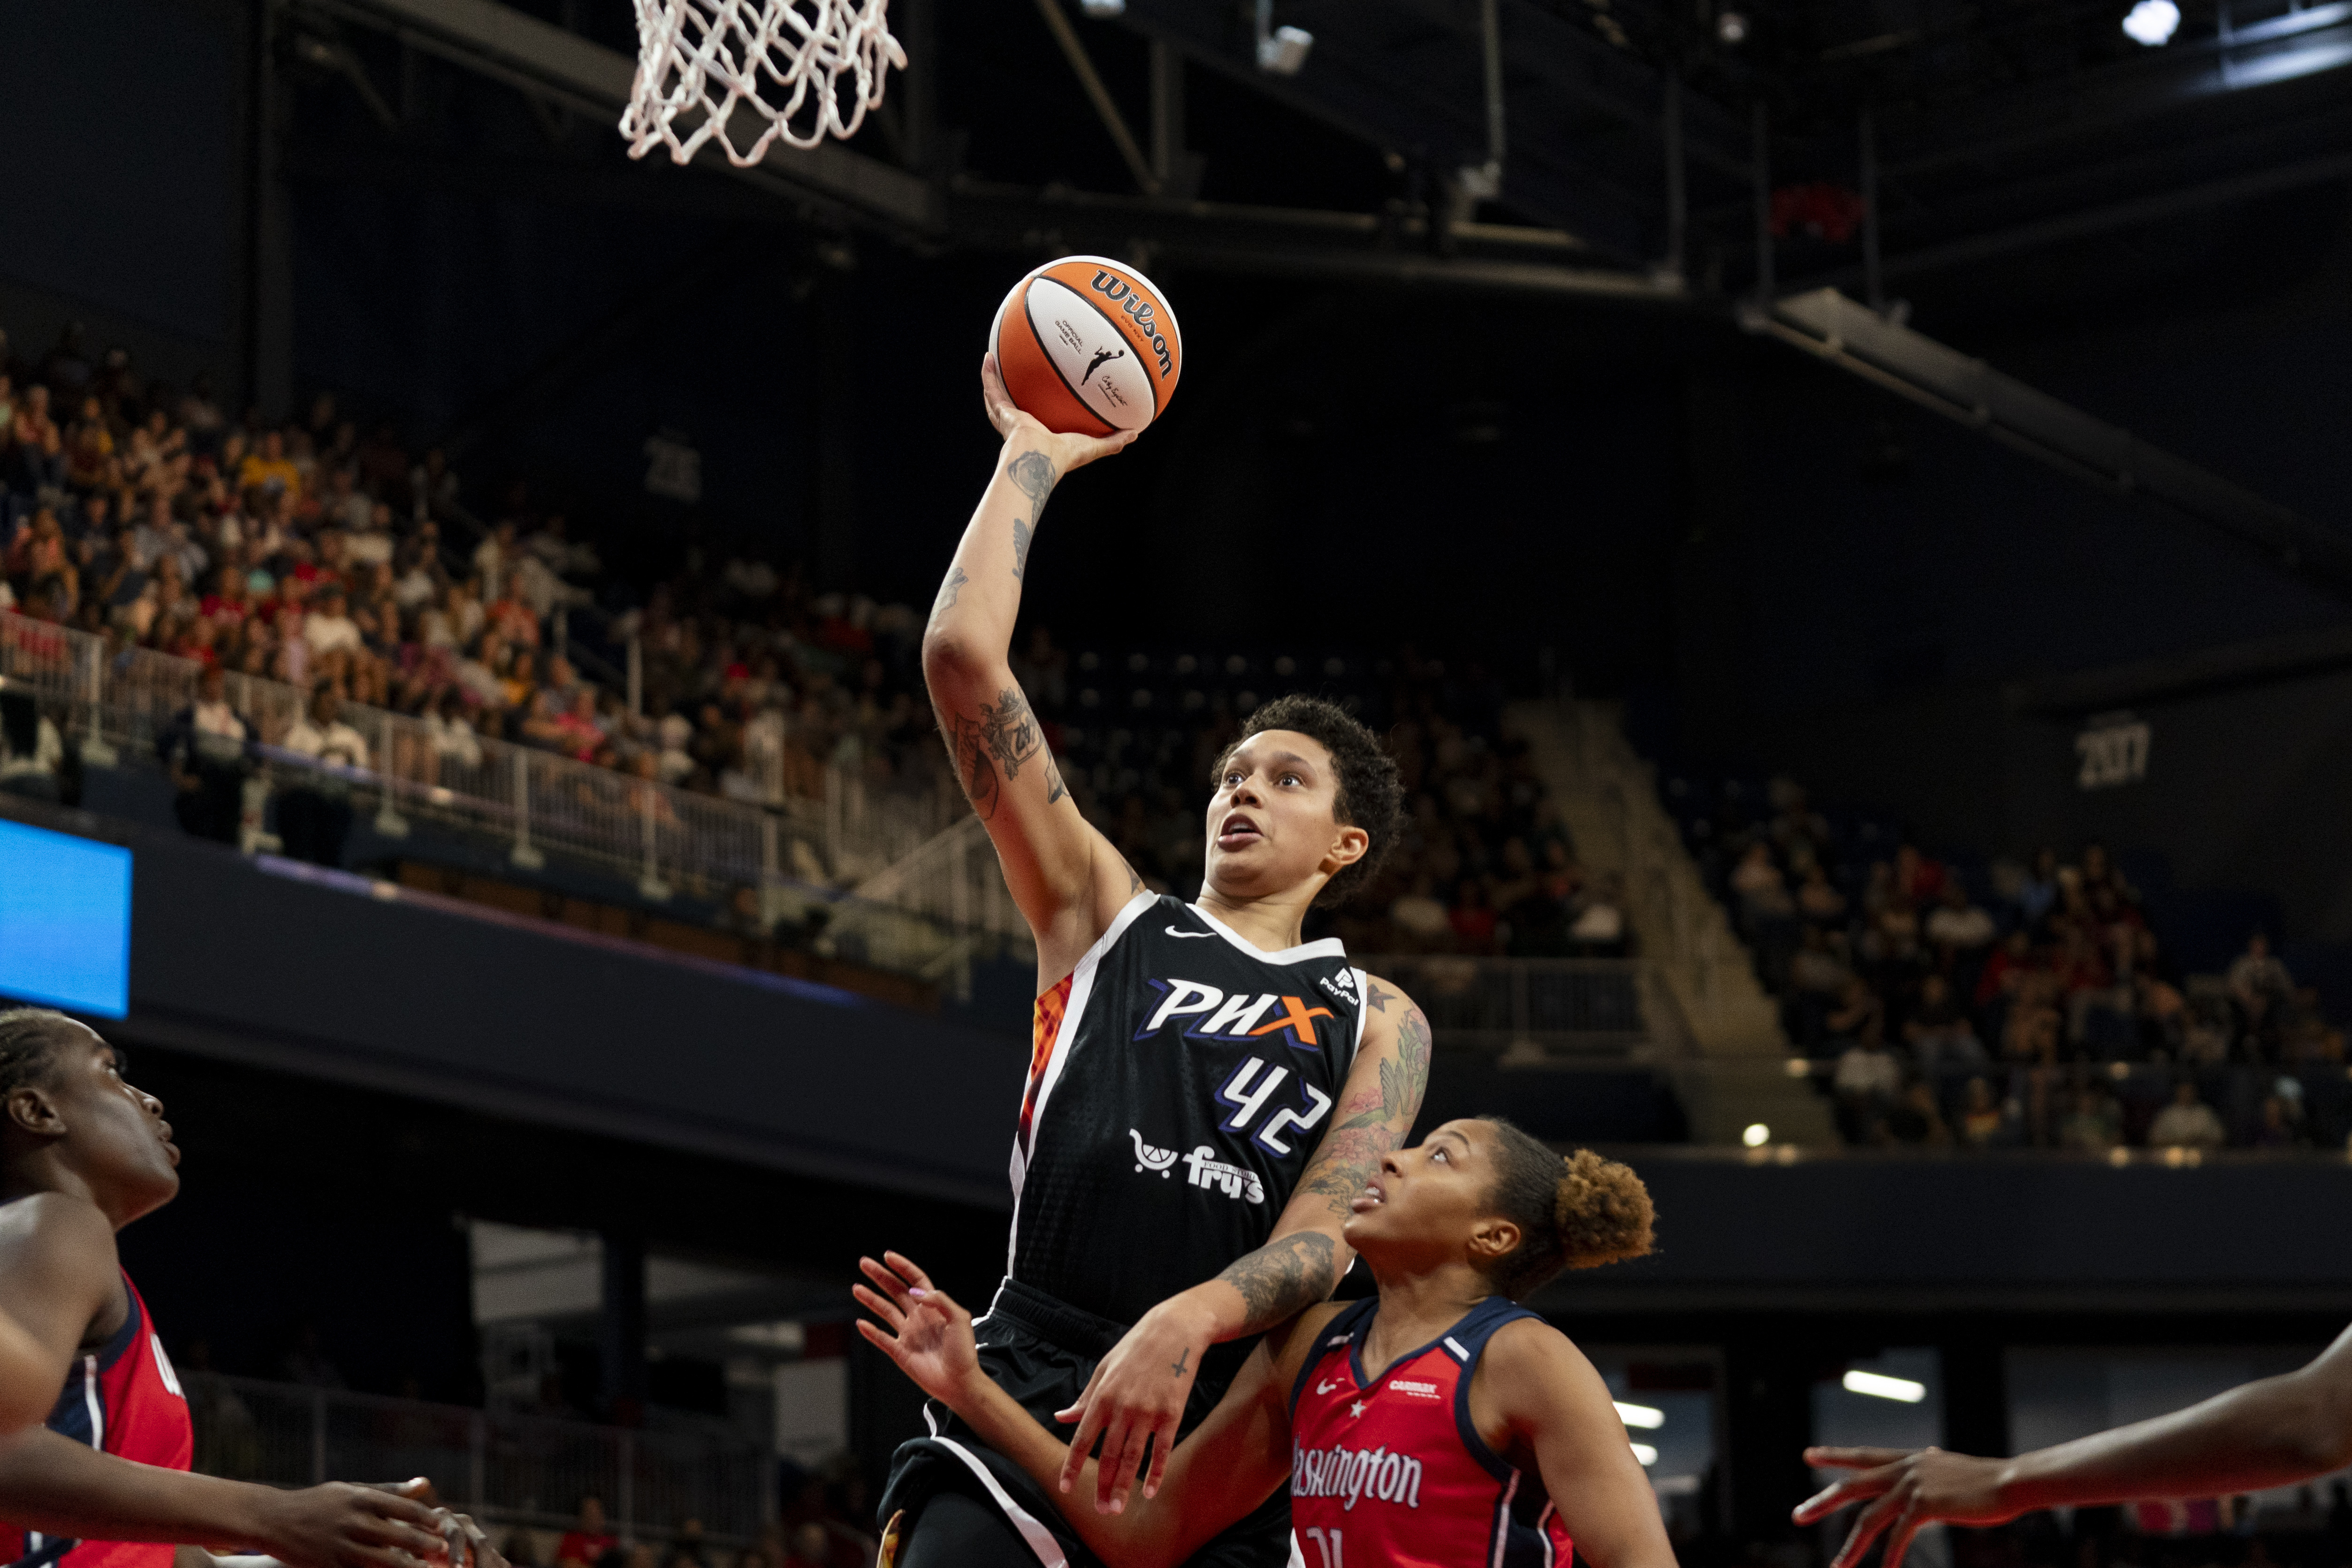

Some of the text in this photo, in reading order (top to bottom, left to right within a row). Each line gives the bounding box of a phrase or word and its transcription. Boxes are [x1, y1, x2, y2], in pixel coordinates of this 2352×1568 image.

[1055, 320, 1081, 355] GAME BALL
[1062, 320, 1082, 347] OFFICIAL
[1090, 269, 1172, 381] Wilson
[1133, 978, 1334, 1052] PHX
[1320, 976, 1359, 1005] PayPal
[1214, 1054, 1332, 1159] 42
[1182, 1145, 1264, 1204] fry's
[1204, 1161, 1229, 1171] FOOD
[1290, 1431, 1423, 1511] ashington
